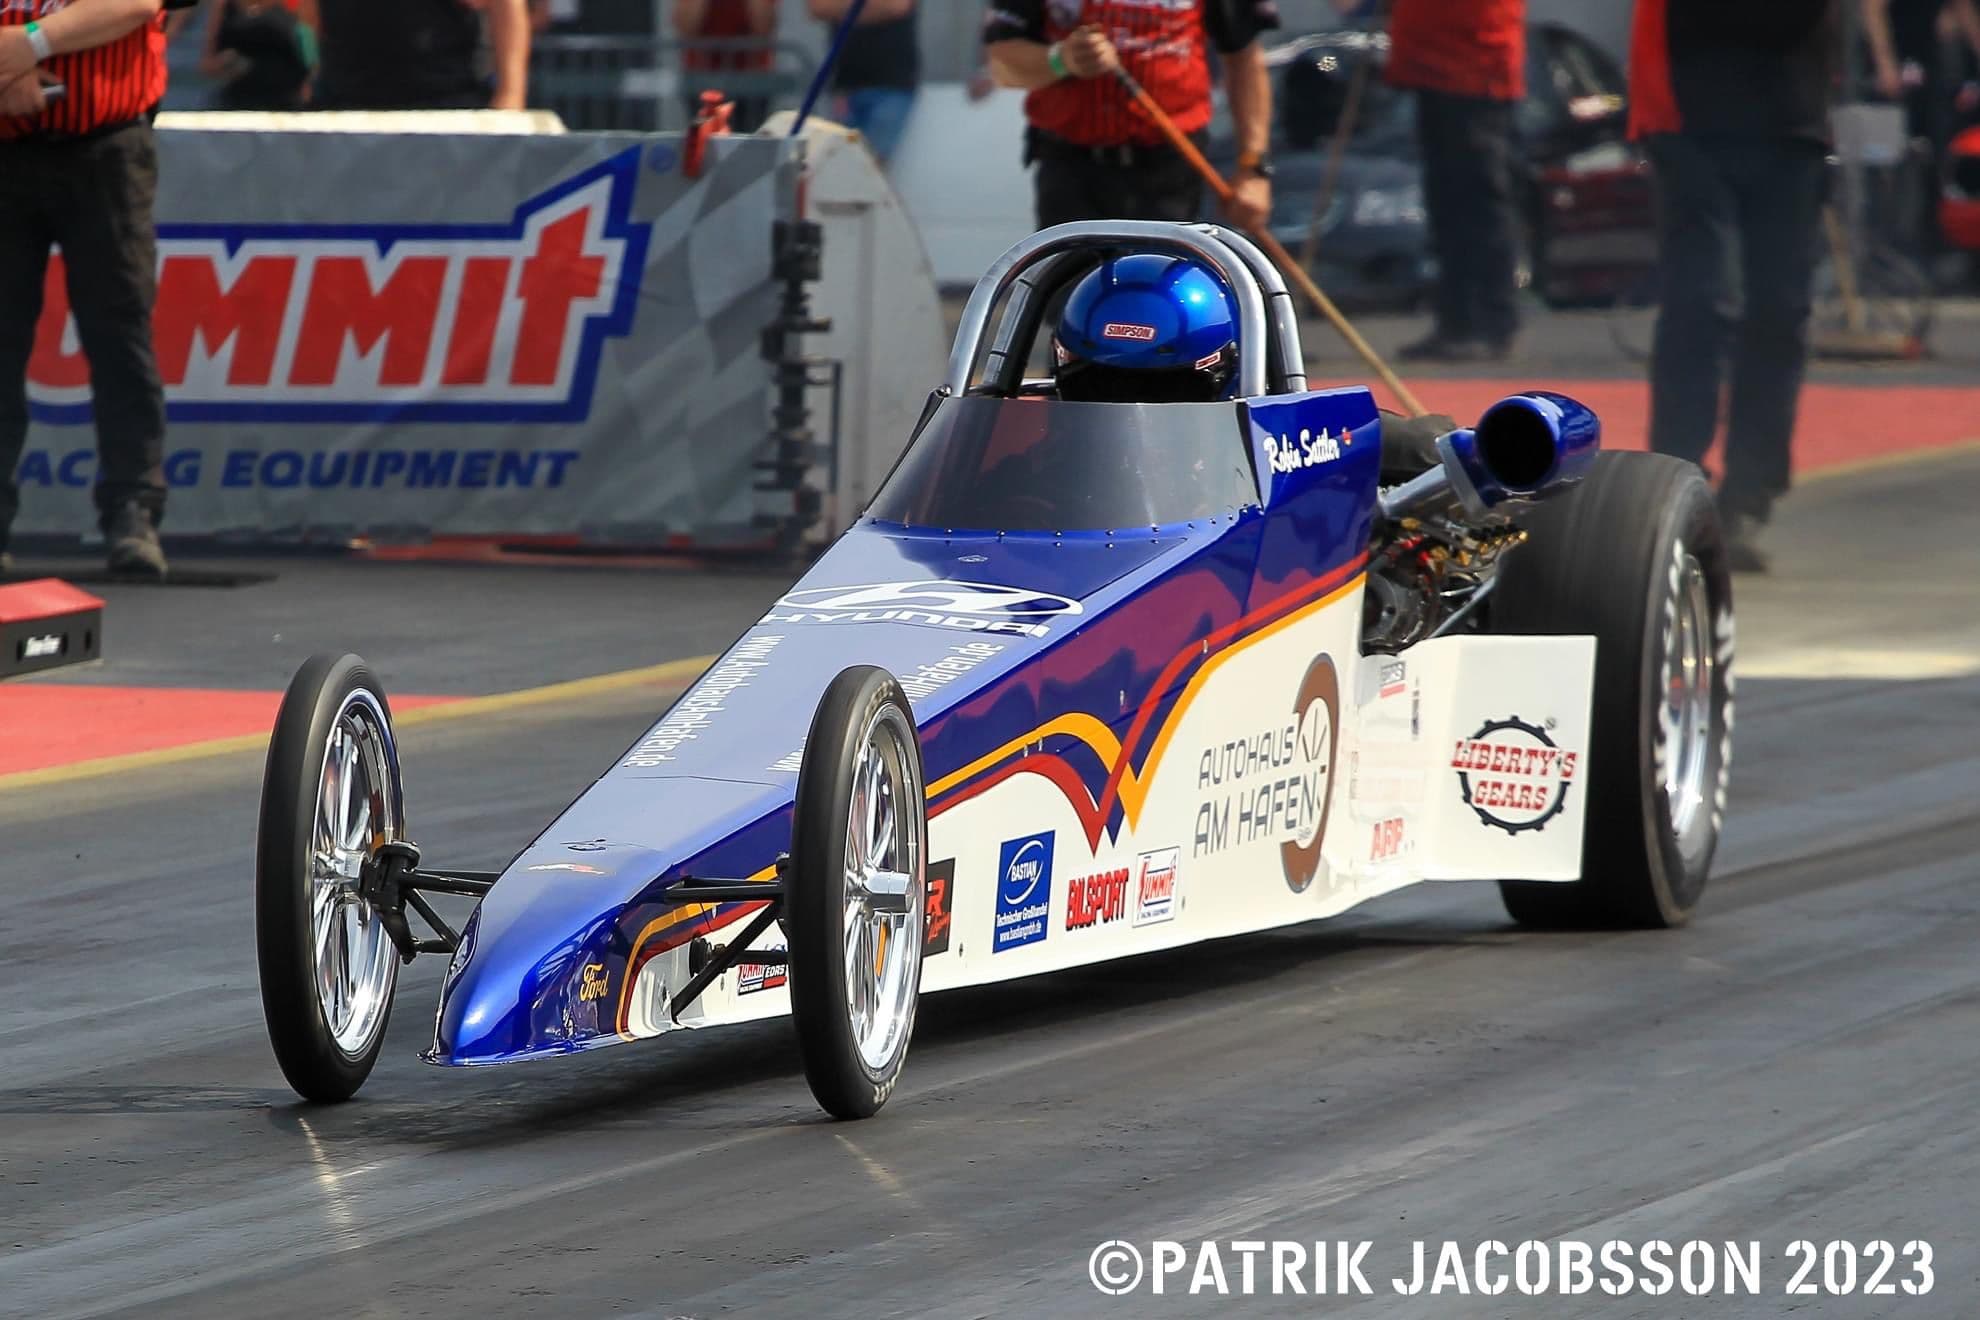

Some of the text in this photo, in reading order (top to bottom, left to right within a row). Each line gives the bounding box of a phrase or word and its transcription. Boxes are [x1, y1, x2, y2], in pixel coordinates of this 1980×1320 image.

[1106, 324, 1151, 339] SIMPSON
[221, 450, 580, 489] EQUIPMENT
[1263, 427, 1340, 474] Robin Sattler
[757, 609, 1051, 639] HYUNDAI
[1198, 725, 1295, 790] AUTOHAUS
[1451, 740, 1577, 779] LIBERTY'S
[1193, 794, 1231, 859] AM
[1237, 769, 1318, 847] HAFEN
[1474, 780, 1549, 811] GEARS
[1010, 860, 1039, 883] BASTIAN
[1066, 867, 1130, 932] BILSPORT
[579, 963, 609, 1002] Ford
